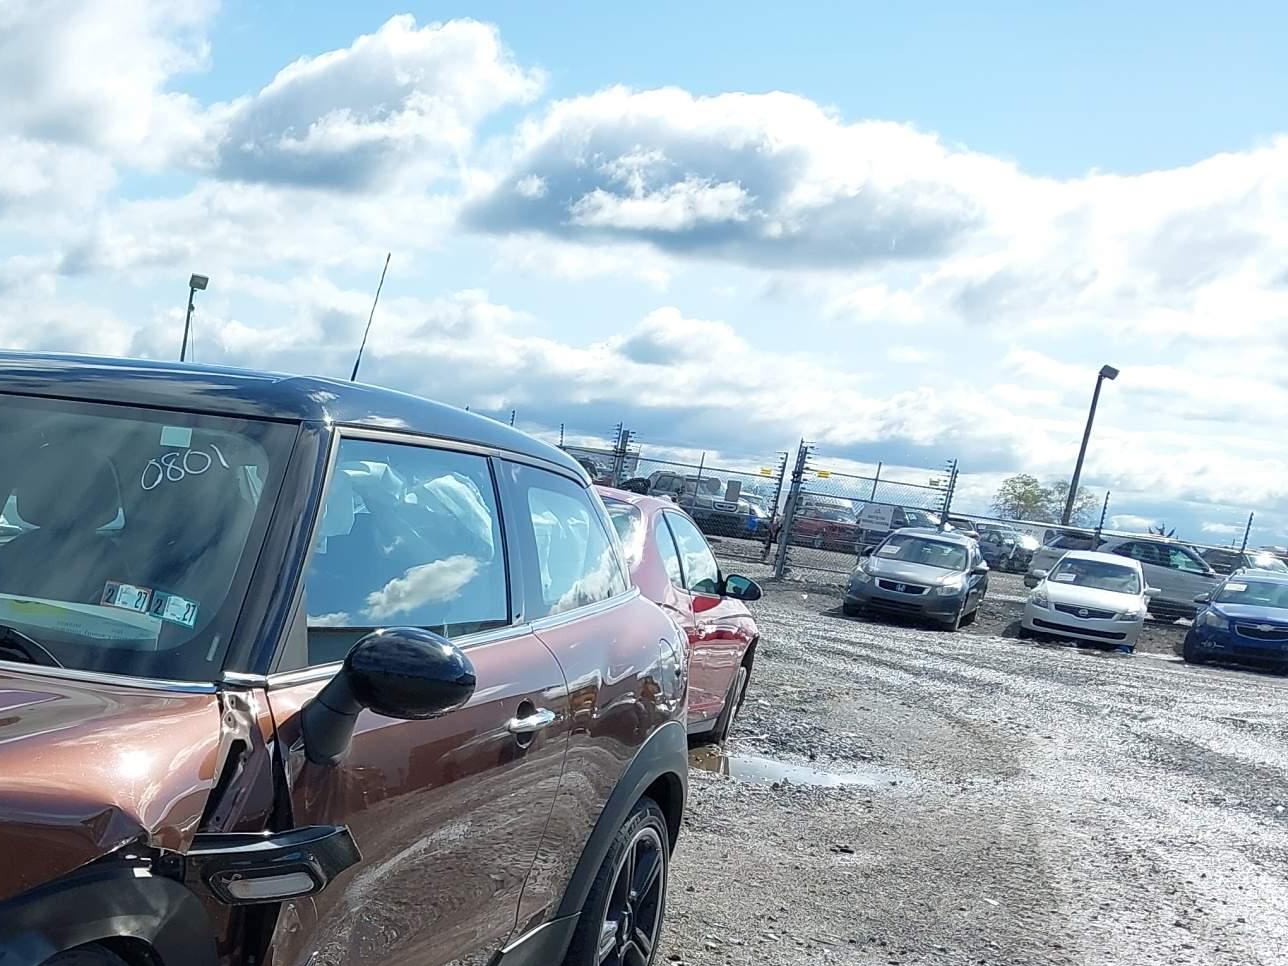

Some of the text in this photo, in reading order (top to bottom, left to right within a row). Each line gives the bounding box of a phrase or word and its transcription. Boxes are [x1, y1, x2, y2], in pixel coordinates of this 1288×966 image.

[141, 444, 230, 490] 0801
[134, 591, 148, 610] 27
[183, 603, 197, 623] 27
